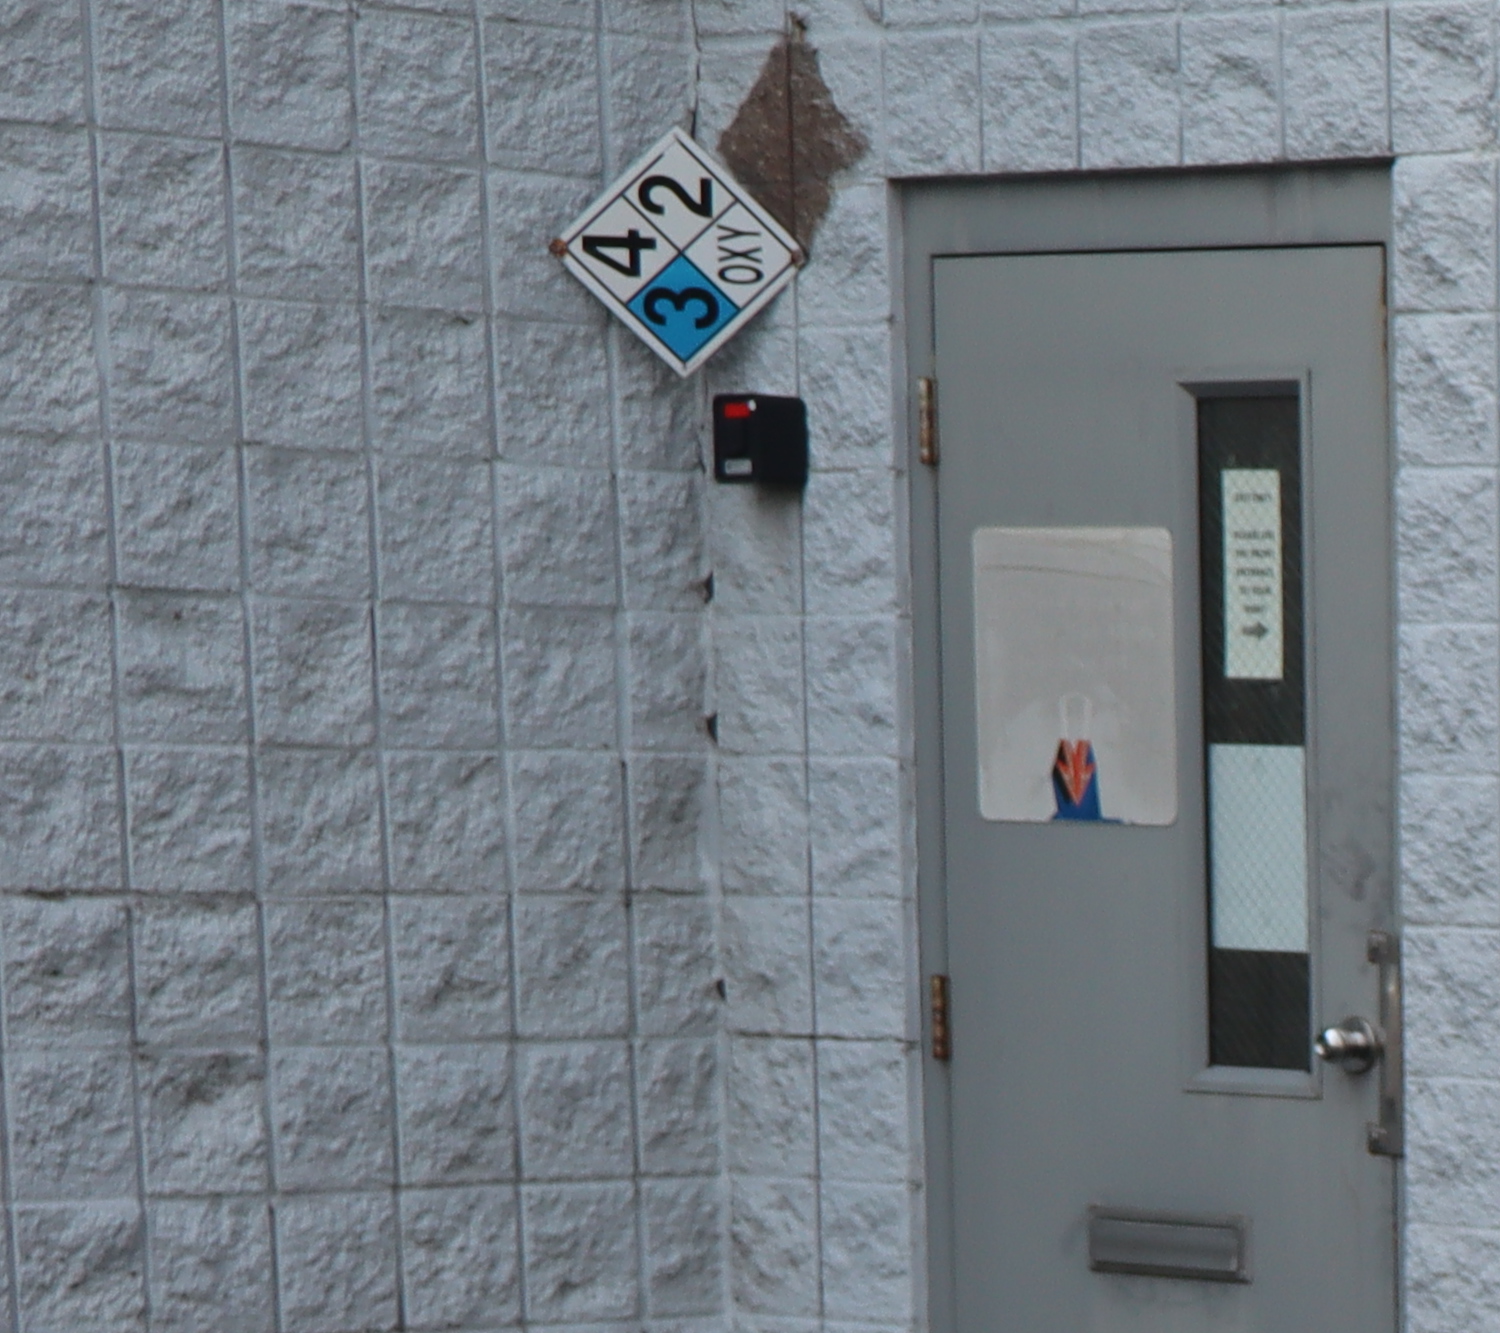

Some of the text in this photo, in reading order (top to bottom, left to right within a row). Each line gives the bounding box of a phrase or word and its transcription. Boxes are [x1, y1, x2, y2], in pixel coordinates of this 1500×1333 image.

[638, 175, 713, 218] 2
[582, 229, 657, 277] 4
[716, 224, 764, 285] OXY
[643, 286, 720, 329] 3
